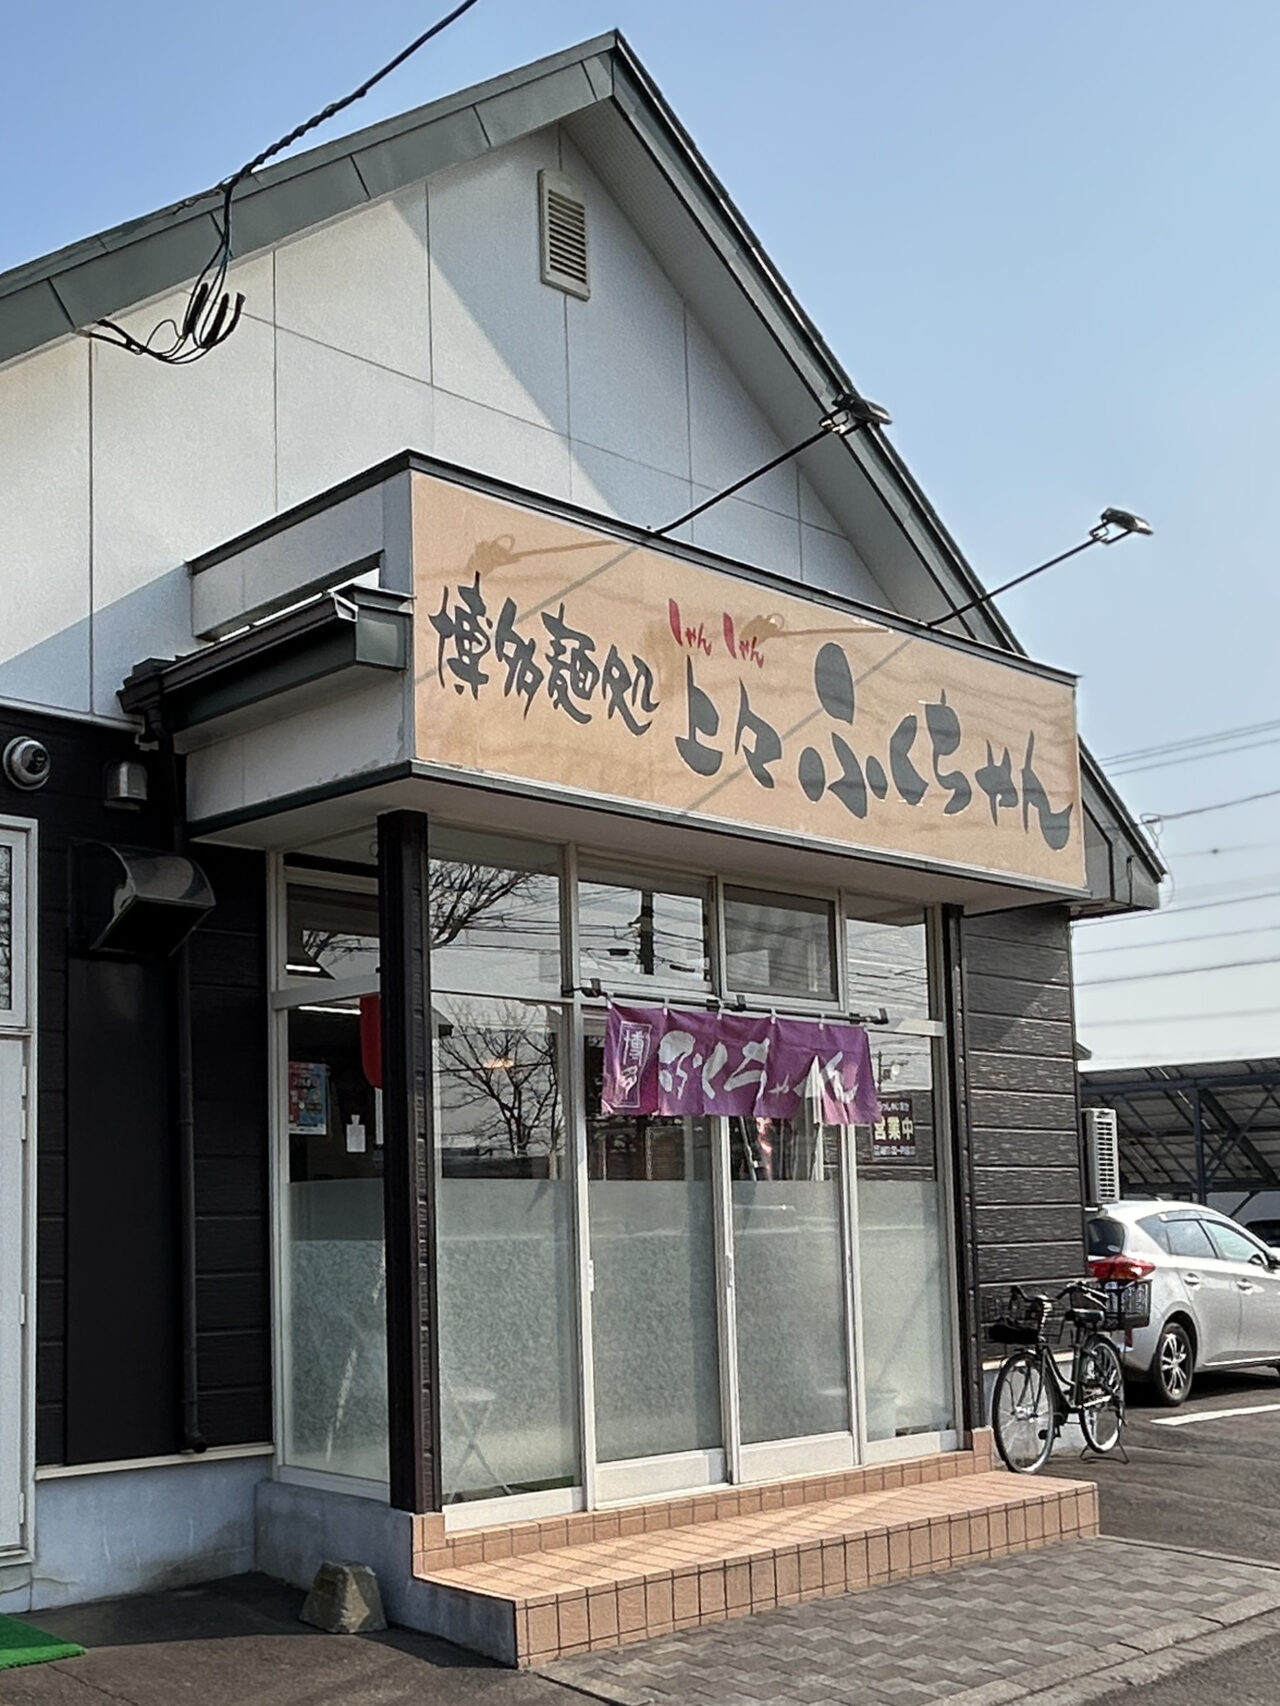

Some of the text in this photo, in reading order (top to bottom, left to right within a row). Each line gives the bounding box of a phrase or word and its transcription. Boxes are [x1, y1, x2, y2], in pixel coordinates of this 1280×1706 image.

[428, 571, 660, 736] 博多麺処
[873, 1115, 914, 1141] 営業中
